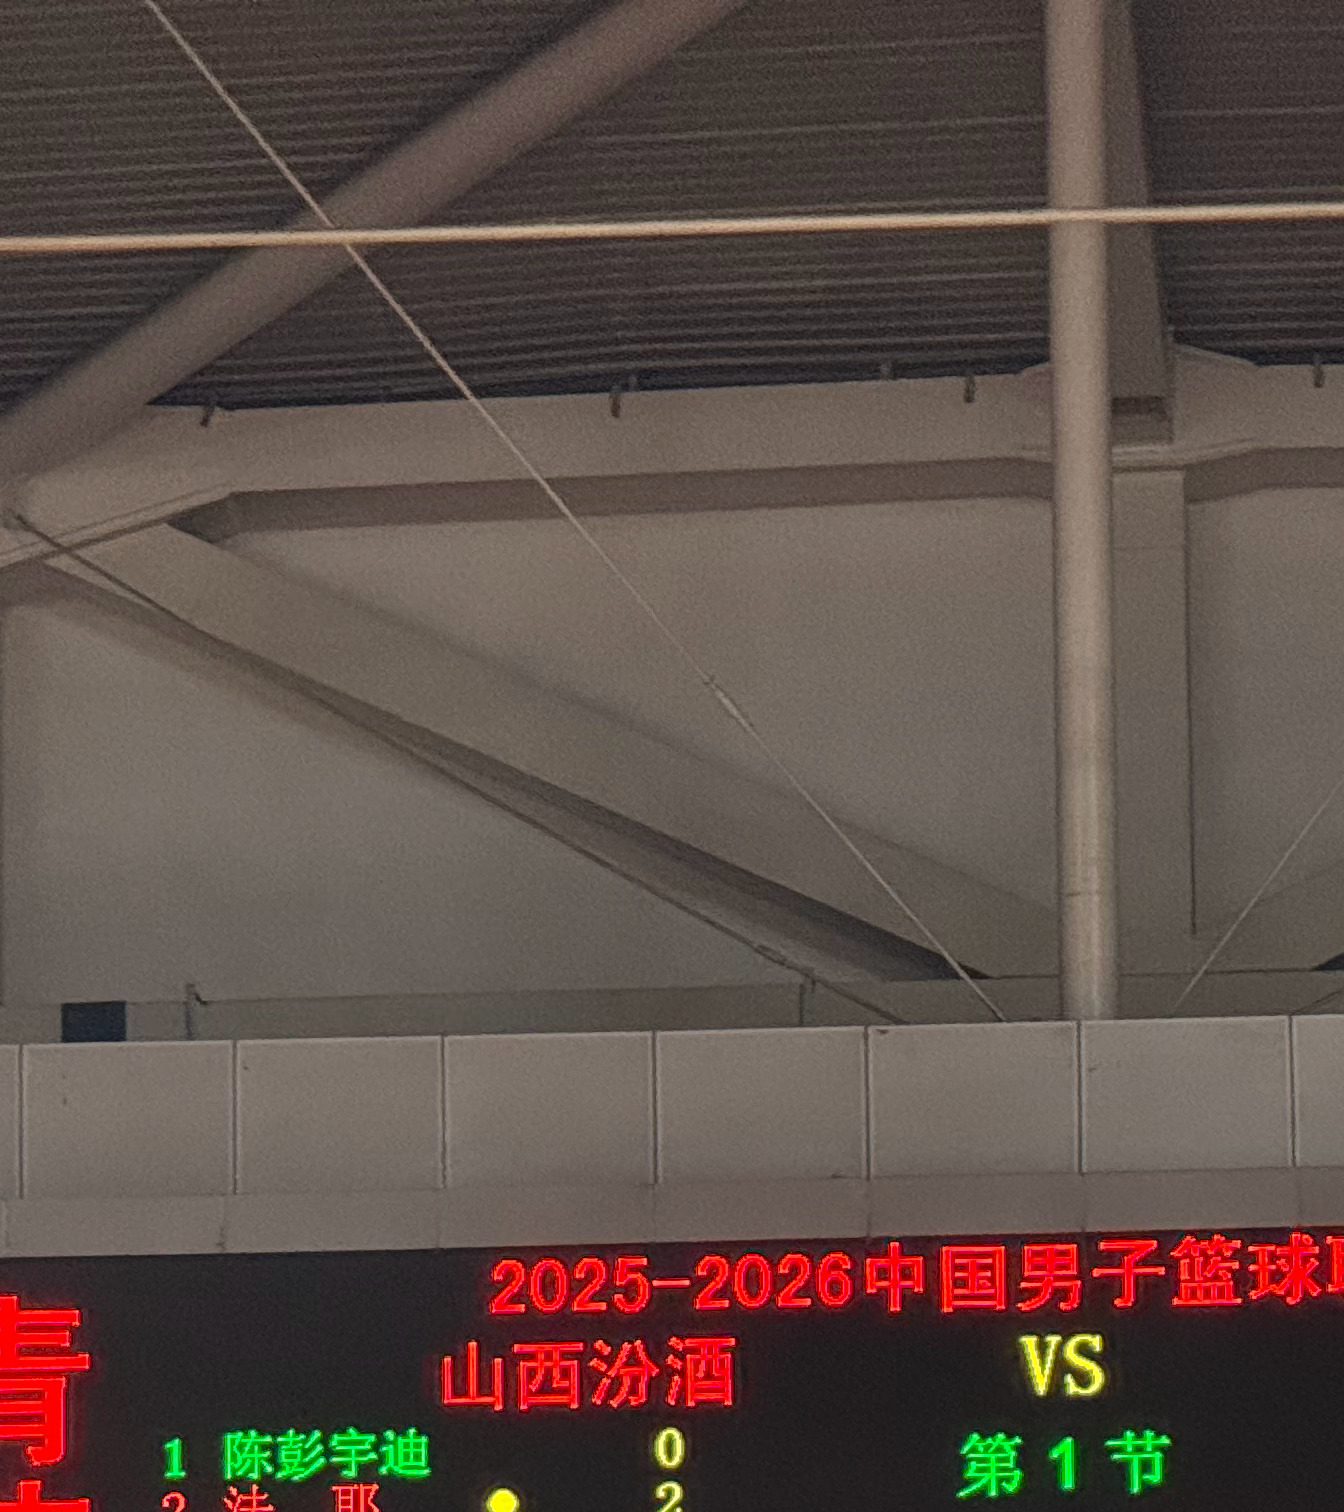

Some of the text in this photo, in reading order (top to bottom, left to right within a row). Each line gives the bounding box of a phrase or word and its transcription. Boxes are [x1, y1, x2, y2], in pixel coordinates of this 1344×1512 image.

[444, 1337, 738, 1413] 山西汾酒
[1020, 1334, 1106, 1397] VS
[163, 1427, 686, 1481] 1 陈彭宇迪 0
